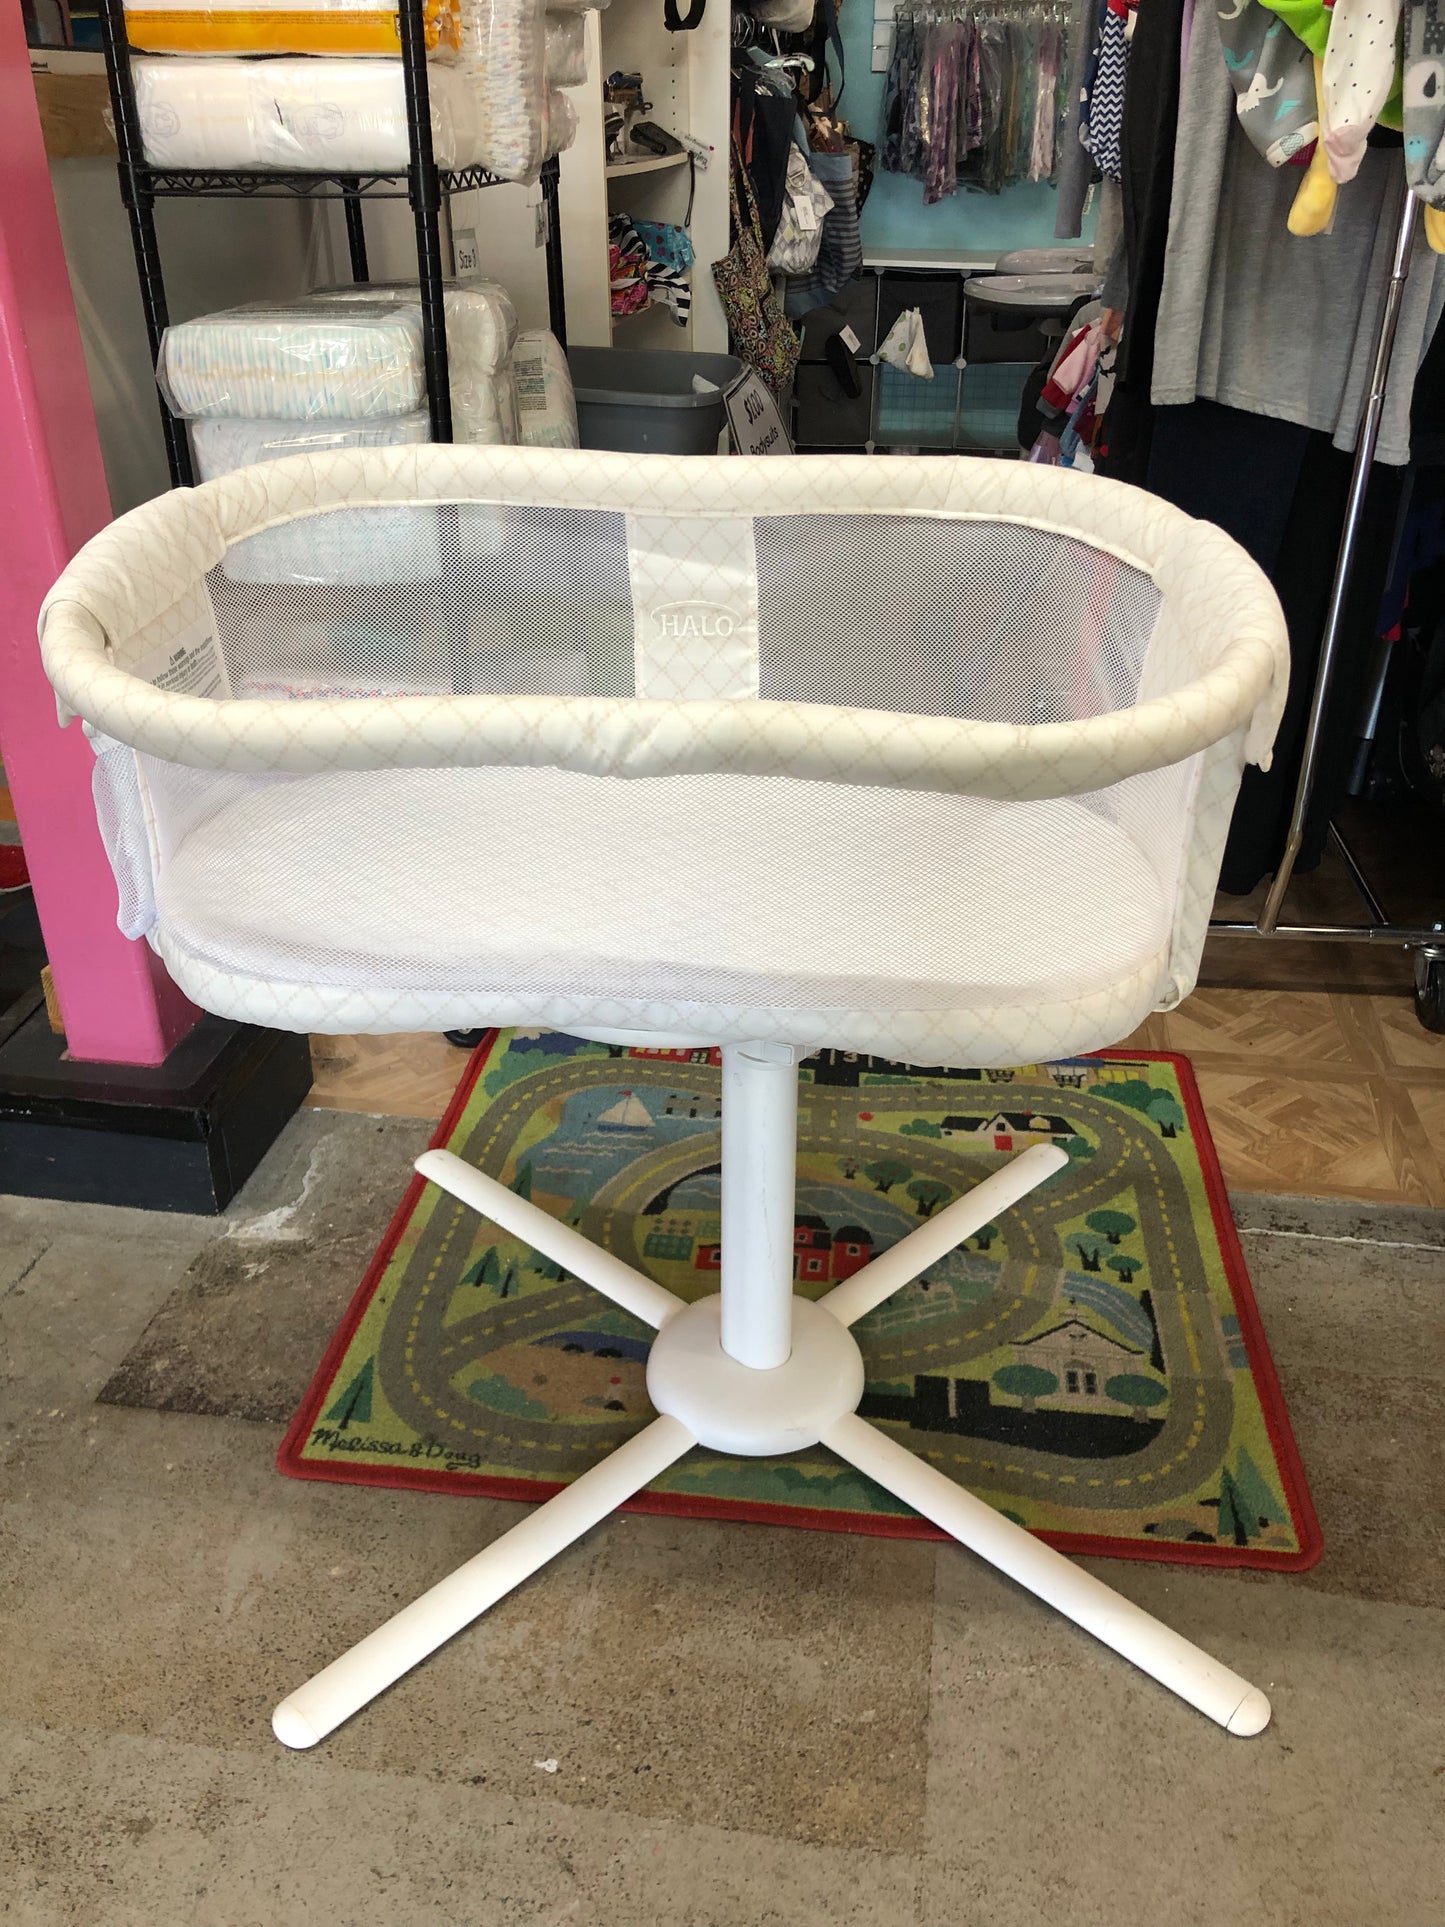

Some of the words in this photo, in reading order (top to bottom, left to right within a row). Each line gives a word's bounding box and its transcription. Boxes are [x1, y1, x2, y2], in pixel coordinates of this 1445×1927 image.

[459, 250, 472, 269] Size
[750, 426, 779, 455] Bodysuits
[660, 614, 734, 637] HALO
[312, 1428, 409, 1454] Melissa
[410, 1443, 424, 1458] &
[425, 1441, 481, 1470] Doug
